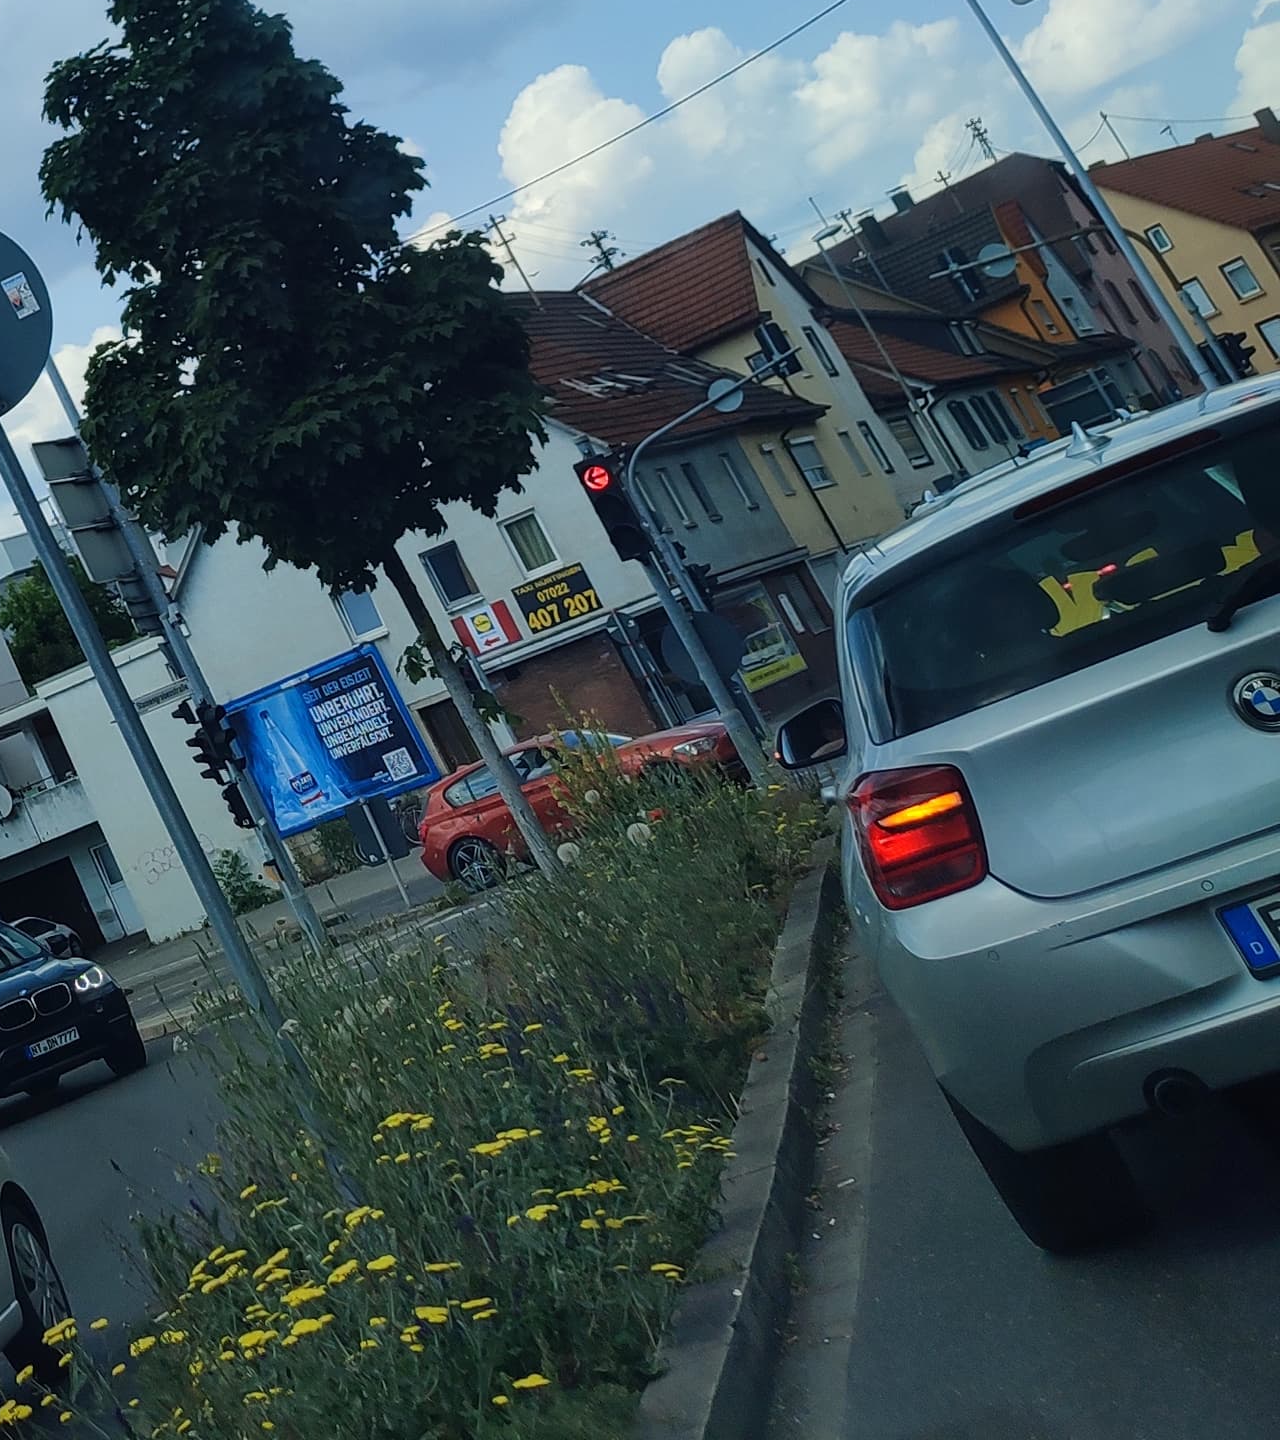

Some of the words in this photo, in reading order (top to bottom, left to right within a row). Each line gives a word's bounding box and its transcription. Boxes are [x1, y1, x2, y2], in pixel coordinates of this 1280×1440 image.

[514, 584, 535, 596] TAXI
[536, 582, 570, 603] 07022
[528, 603, 561, 630] 407
[563, 589, 598, 617] 207
[303, 687, 322, 704] SEIT
[321, 681, 340, 696] DER
[339, 667, 372, 688] EISZEIT
[322, 712, 393, 749] UNBEHANDELT.
[1249, 941, 1264, 955] D
